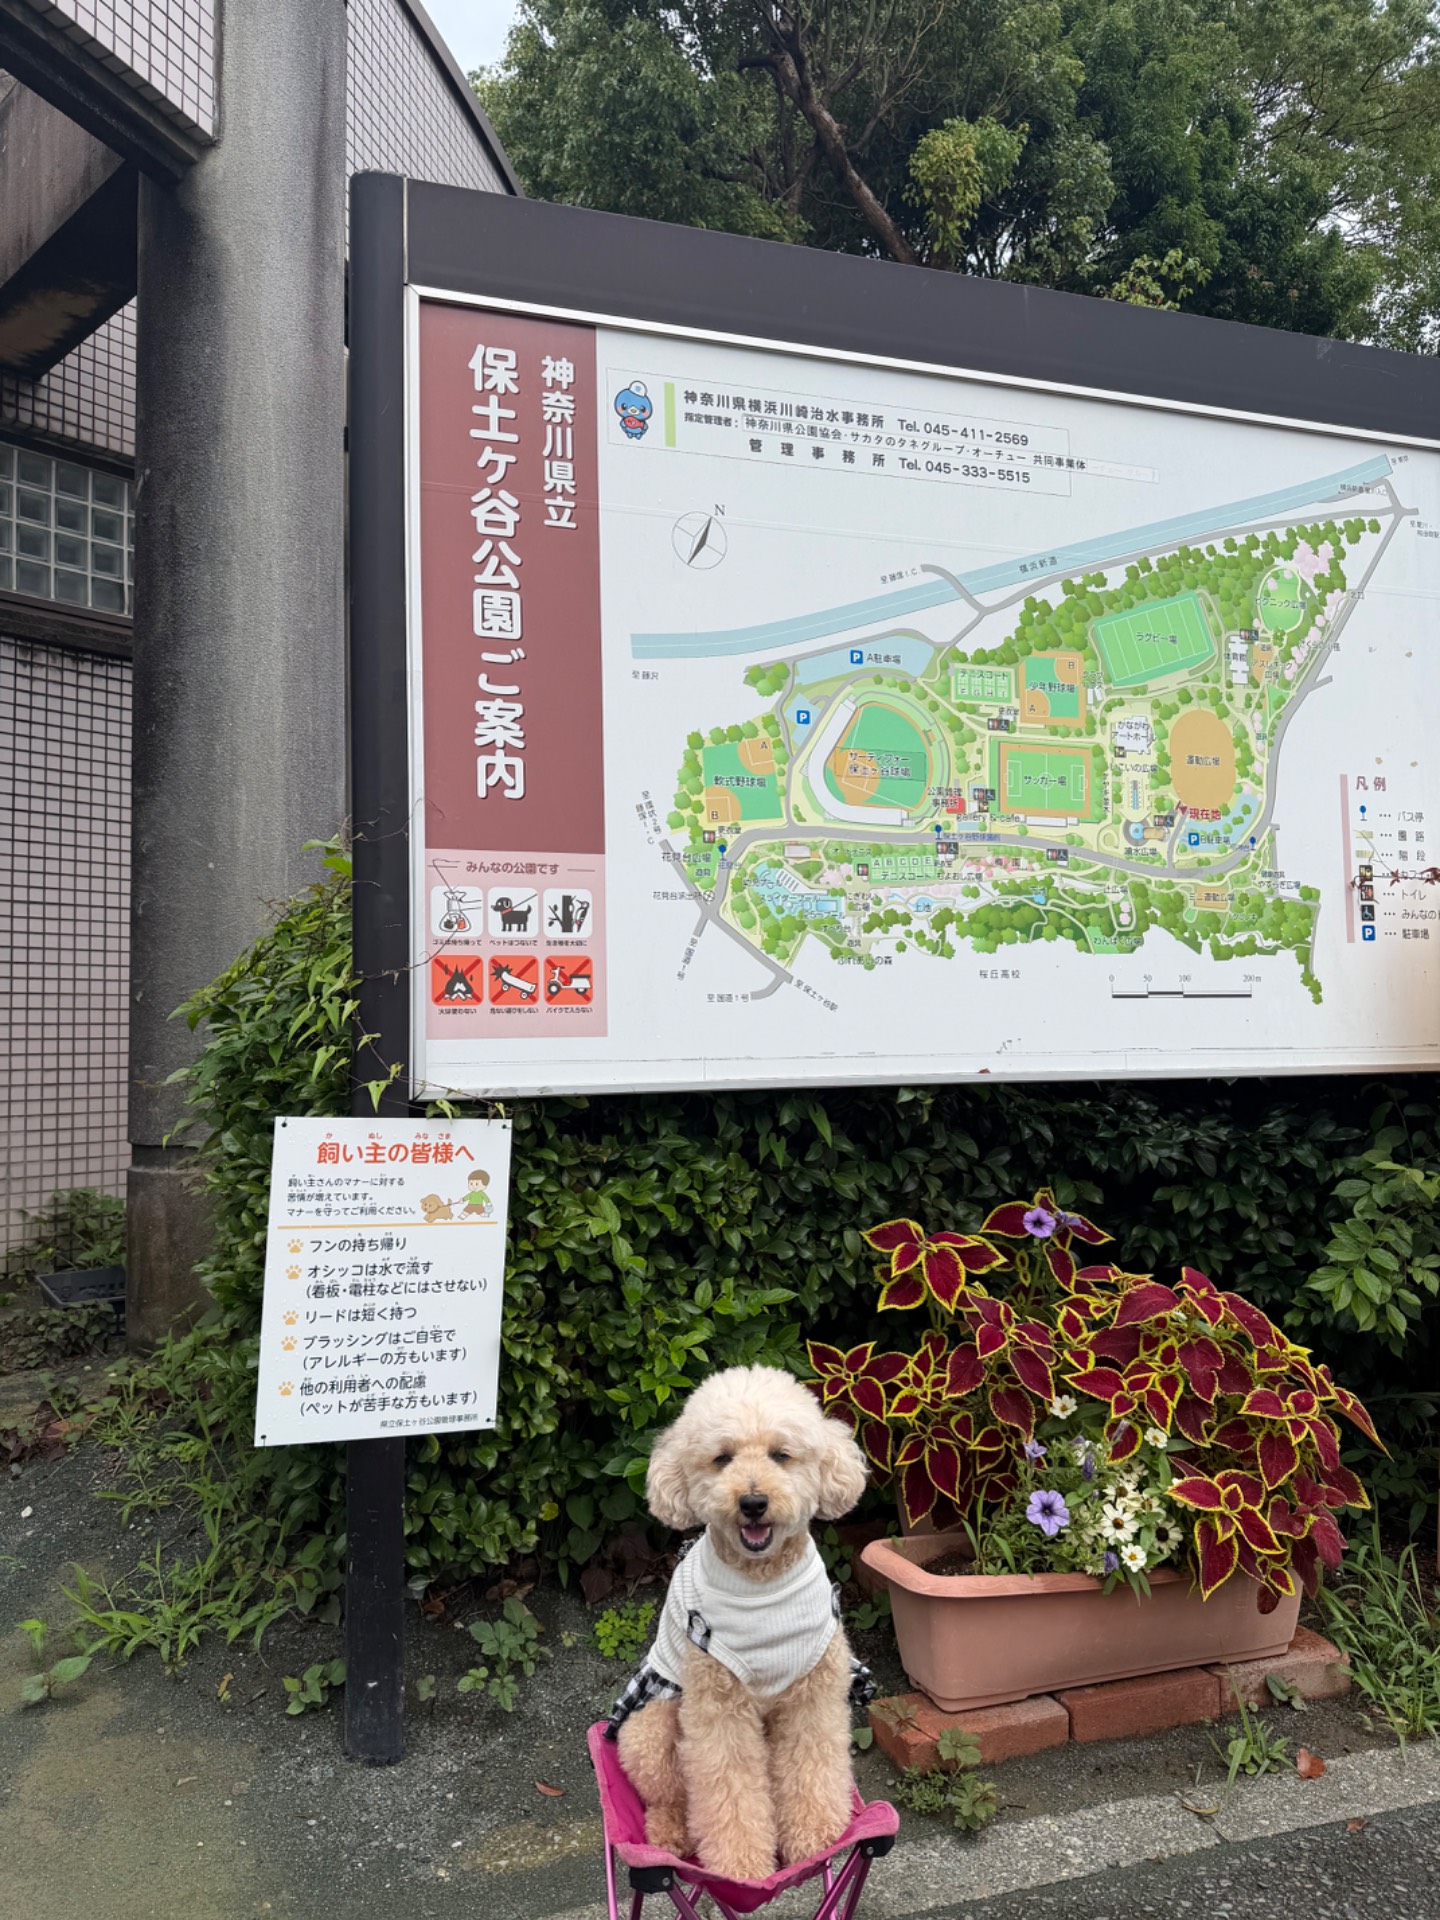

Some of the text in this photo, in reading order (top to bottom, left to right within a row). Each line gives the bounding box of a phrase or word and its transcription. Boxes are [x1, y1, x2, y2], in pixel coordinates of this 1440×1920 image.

[898, 418, 1029, 446] Tel. 045-411-2569
[541, 355, 577, 529] 神奈川県立
[899, 457, 1030, 483] Tel. 045-333-5515
[714, 504, 726, 516] N
[1136, 631, 1178, 645] ラグビー場
[1029, 682, 1075, 693] 少年野球場
[1024, 776, 1067, 787] サッカー場
[1189, 808, 1221, 820] 現在地
[1398, 812, 1424, 822] バス停
[466, 861, 559, 875] みんなの公園です
[881, 872, 931, 881] テニスコート
[1402, 889, 1426, 900] トイレ
[1401, 909, 1440, 920] みんなの
[317, 1142, 474, 1164] 飼い主の皆様へ
[310, 1237, 406, 1253] フンの持ち帰り
[307, 1260, 433, 1278] オシッコは水で流す
[305, 1307, 417, 1324] リードは短く持つ
[303, 1328, 456, 1350] ブラッシングはご自宅で
[300, 1375, 426, 1396] 他の利用者への配慮
